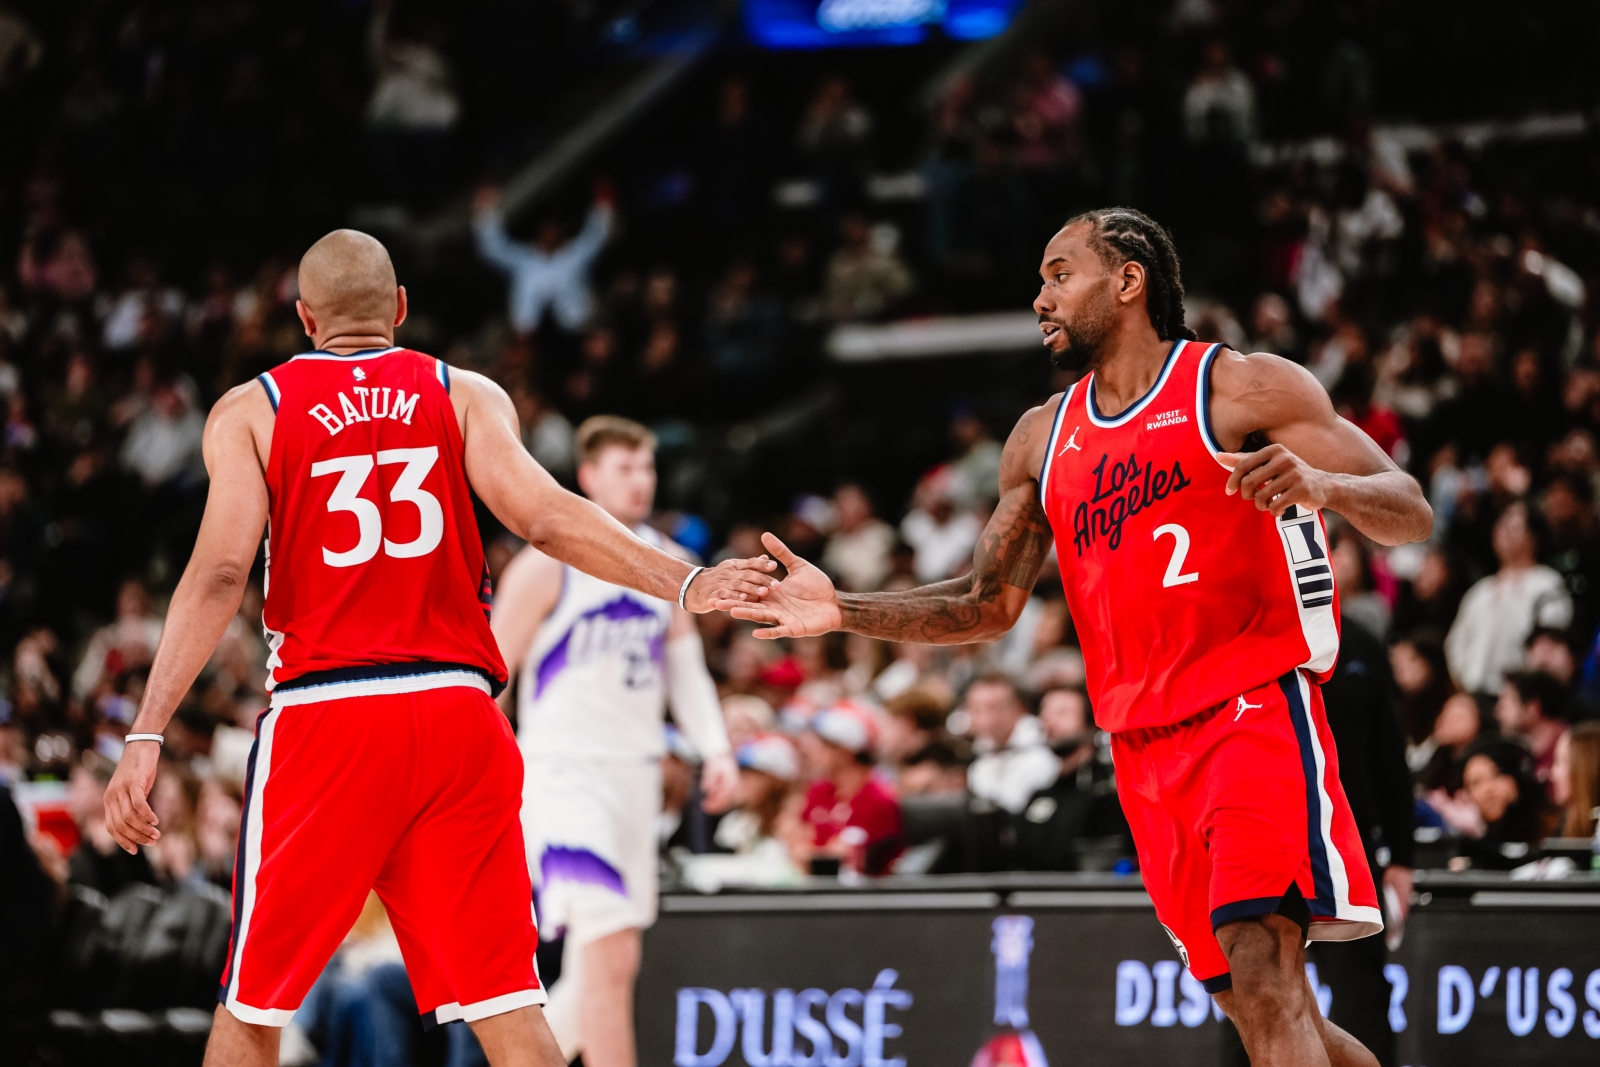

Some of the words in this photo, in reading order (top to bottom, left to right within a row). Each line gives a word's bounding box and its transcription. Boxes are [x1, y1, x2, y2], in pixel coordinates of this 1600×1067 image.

[308, 386, 420, 436] BATUM
[1146, 415, 1188, 431] RWANDA
[1155, 409, 1180, 421] VISIT
[1090, 453, 1143, 504] Los
[311, 446, 444, 567] 33
[1073, 460, 1191, 558] Angeles
[1152, 523, 1199, 588] 2
